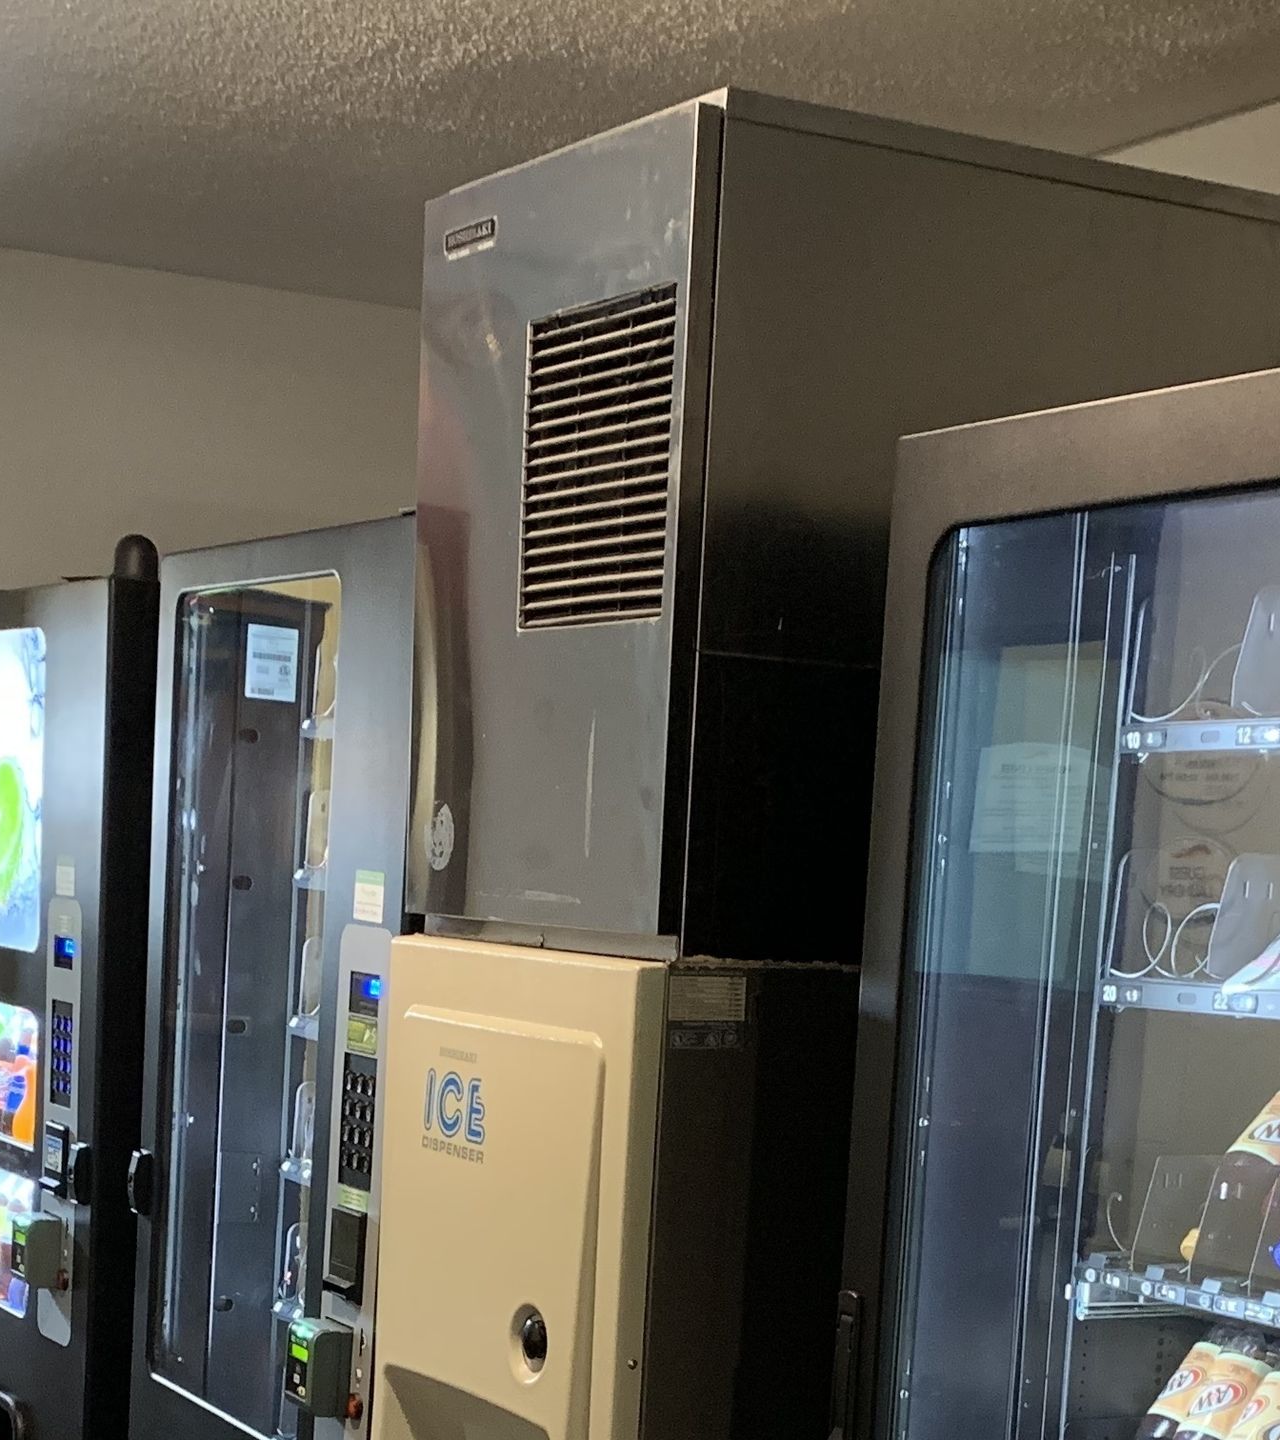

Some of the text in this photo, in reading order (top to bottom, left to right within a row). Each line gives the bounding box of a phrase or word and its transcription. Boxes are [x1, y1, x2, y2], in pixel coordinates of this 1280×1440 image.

[1127, 732, 1140, 749] 10
[1236, 727, 1251, 743] 12
[1103, 986, 1116, 1001] 20
[1214, 992, 1228, 1009] 22
[424, 1067, 485, 1145] ICE
[421, 1135, 484, 1164] DISPENSER
